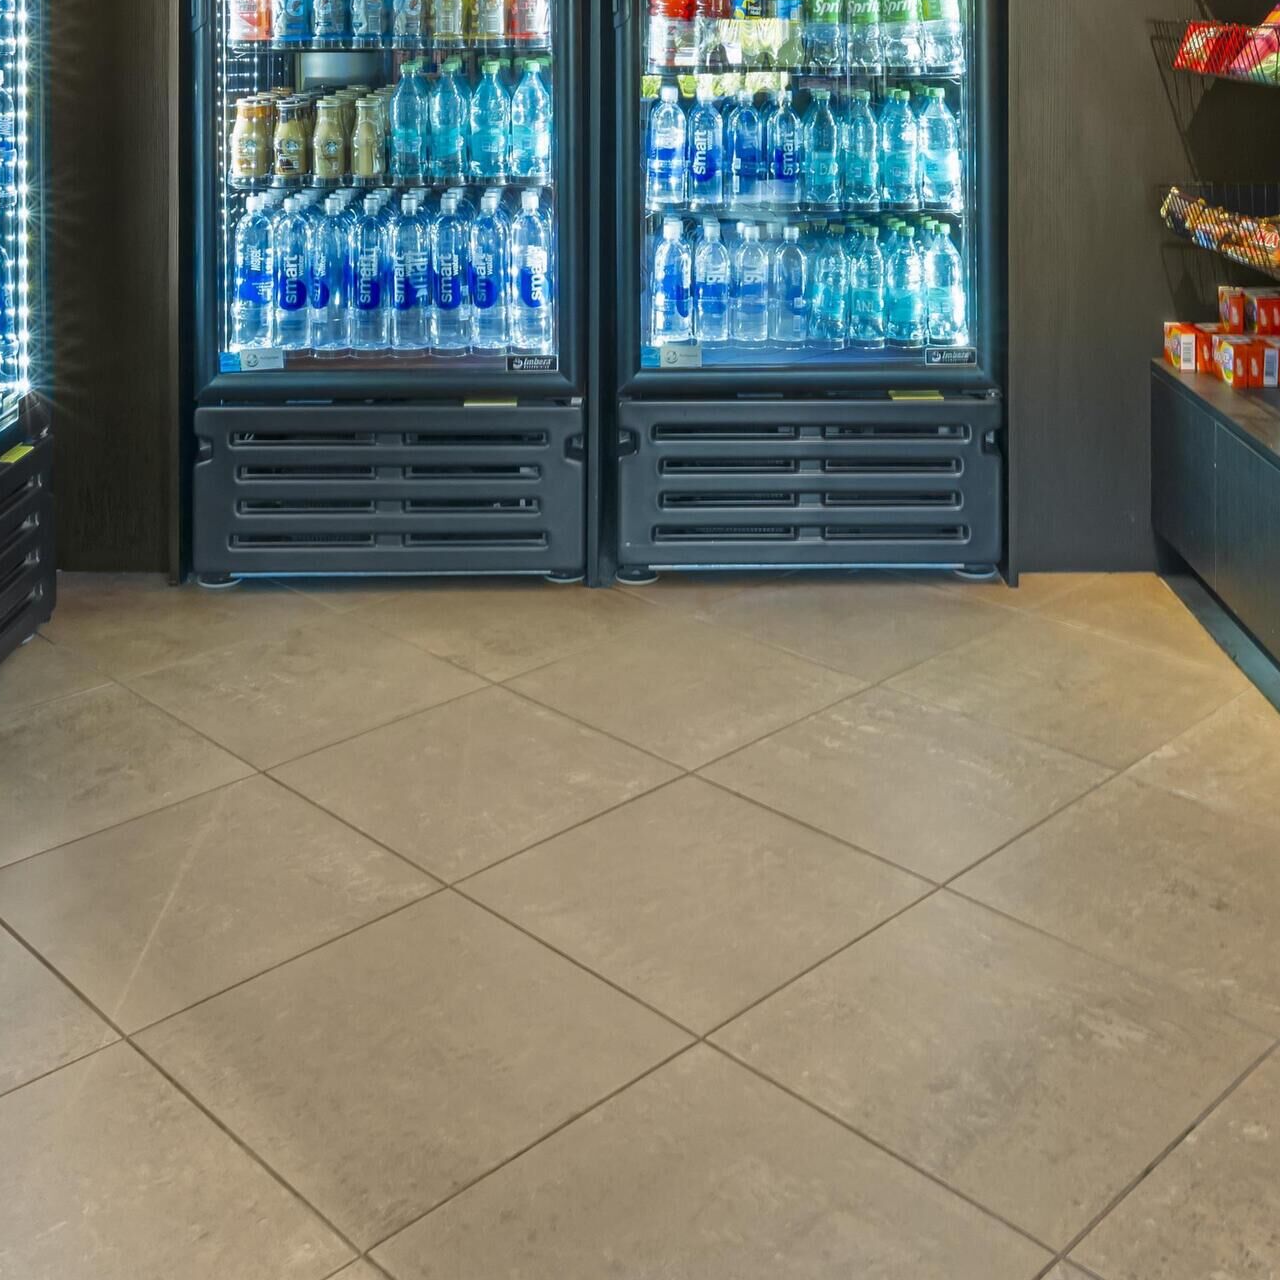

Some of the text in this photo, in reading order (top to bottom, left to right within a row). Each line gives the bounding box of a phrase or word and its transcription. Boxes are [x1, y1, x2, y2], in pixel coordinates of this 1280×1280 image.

[693, 130, 707, 176] smart
[285, 254, 298, 304] smart
[440, 254, 453, 304] smart
